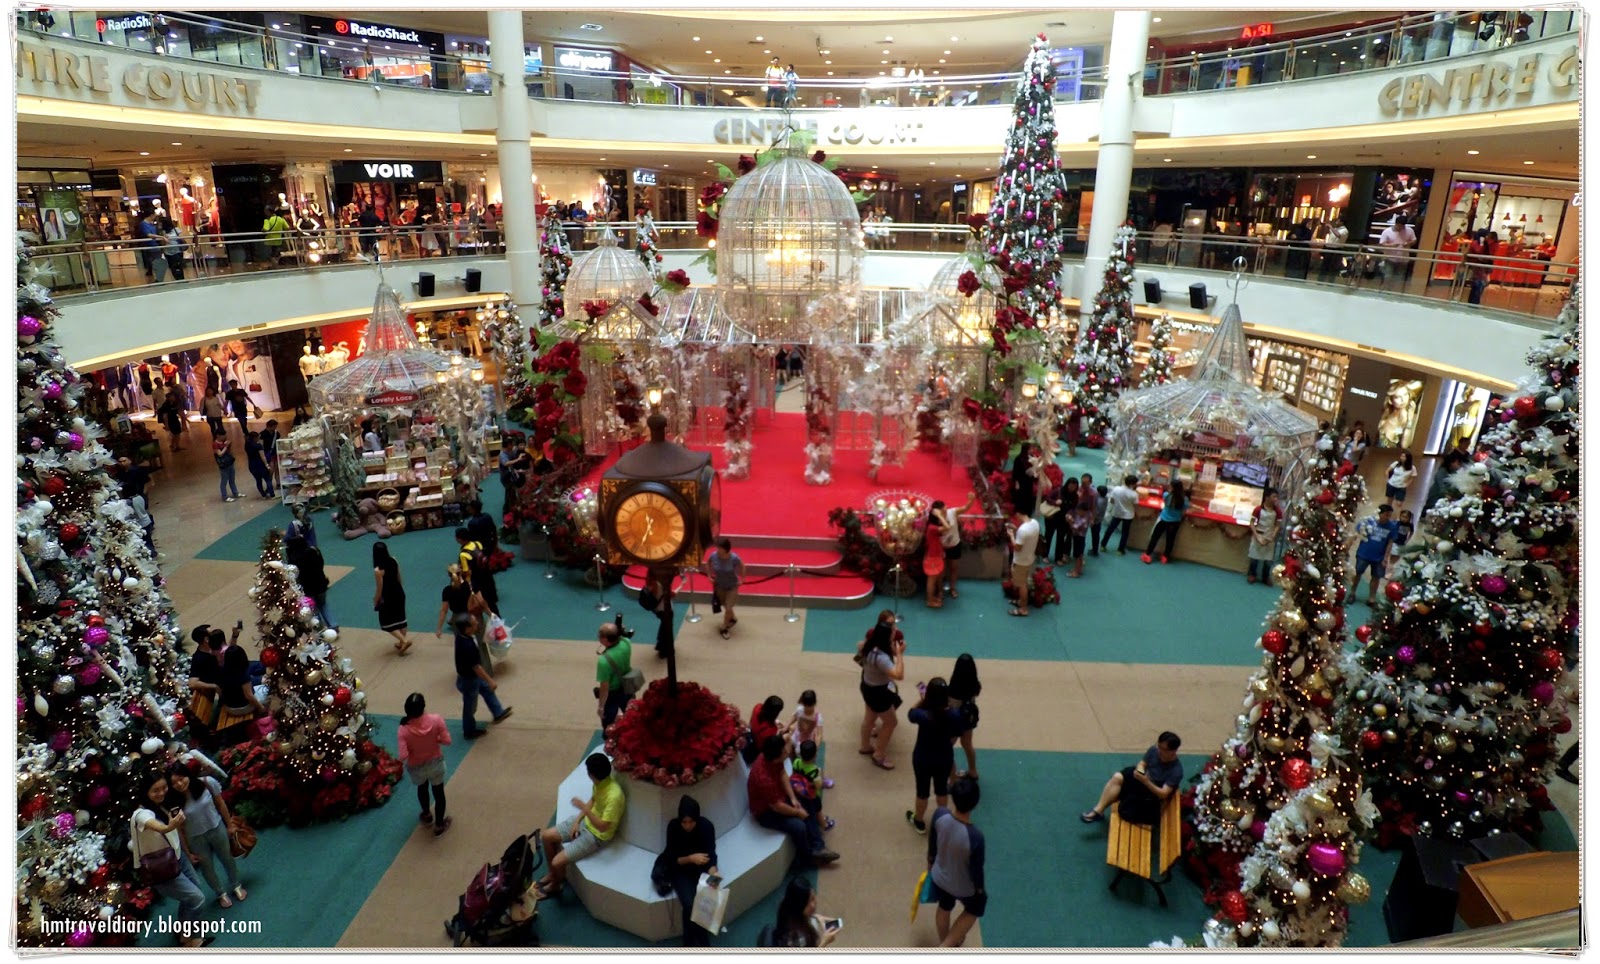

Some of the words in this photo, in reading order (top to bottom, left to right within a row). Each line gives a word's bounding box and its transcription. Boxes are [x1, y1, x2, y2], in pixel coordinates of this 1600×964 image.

[107, 15, 152, 30] RadioSh
[350, 22, 419, 42] RadioShack
[17, 41, 112, 93] TRE
[122, 62, 262, 109] COURT
[1378, 52, 1542, 111] CENTRE
[1547, 45, 1579, 88] C
[363, 163, 414, 178] VOIR
[371, 396, 394, 404] Lovely
